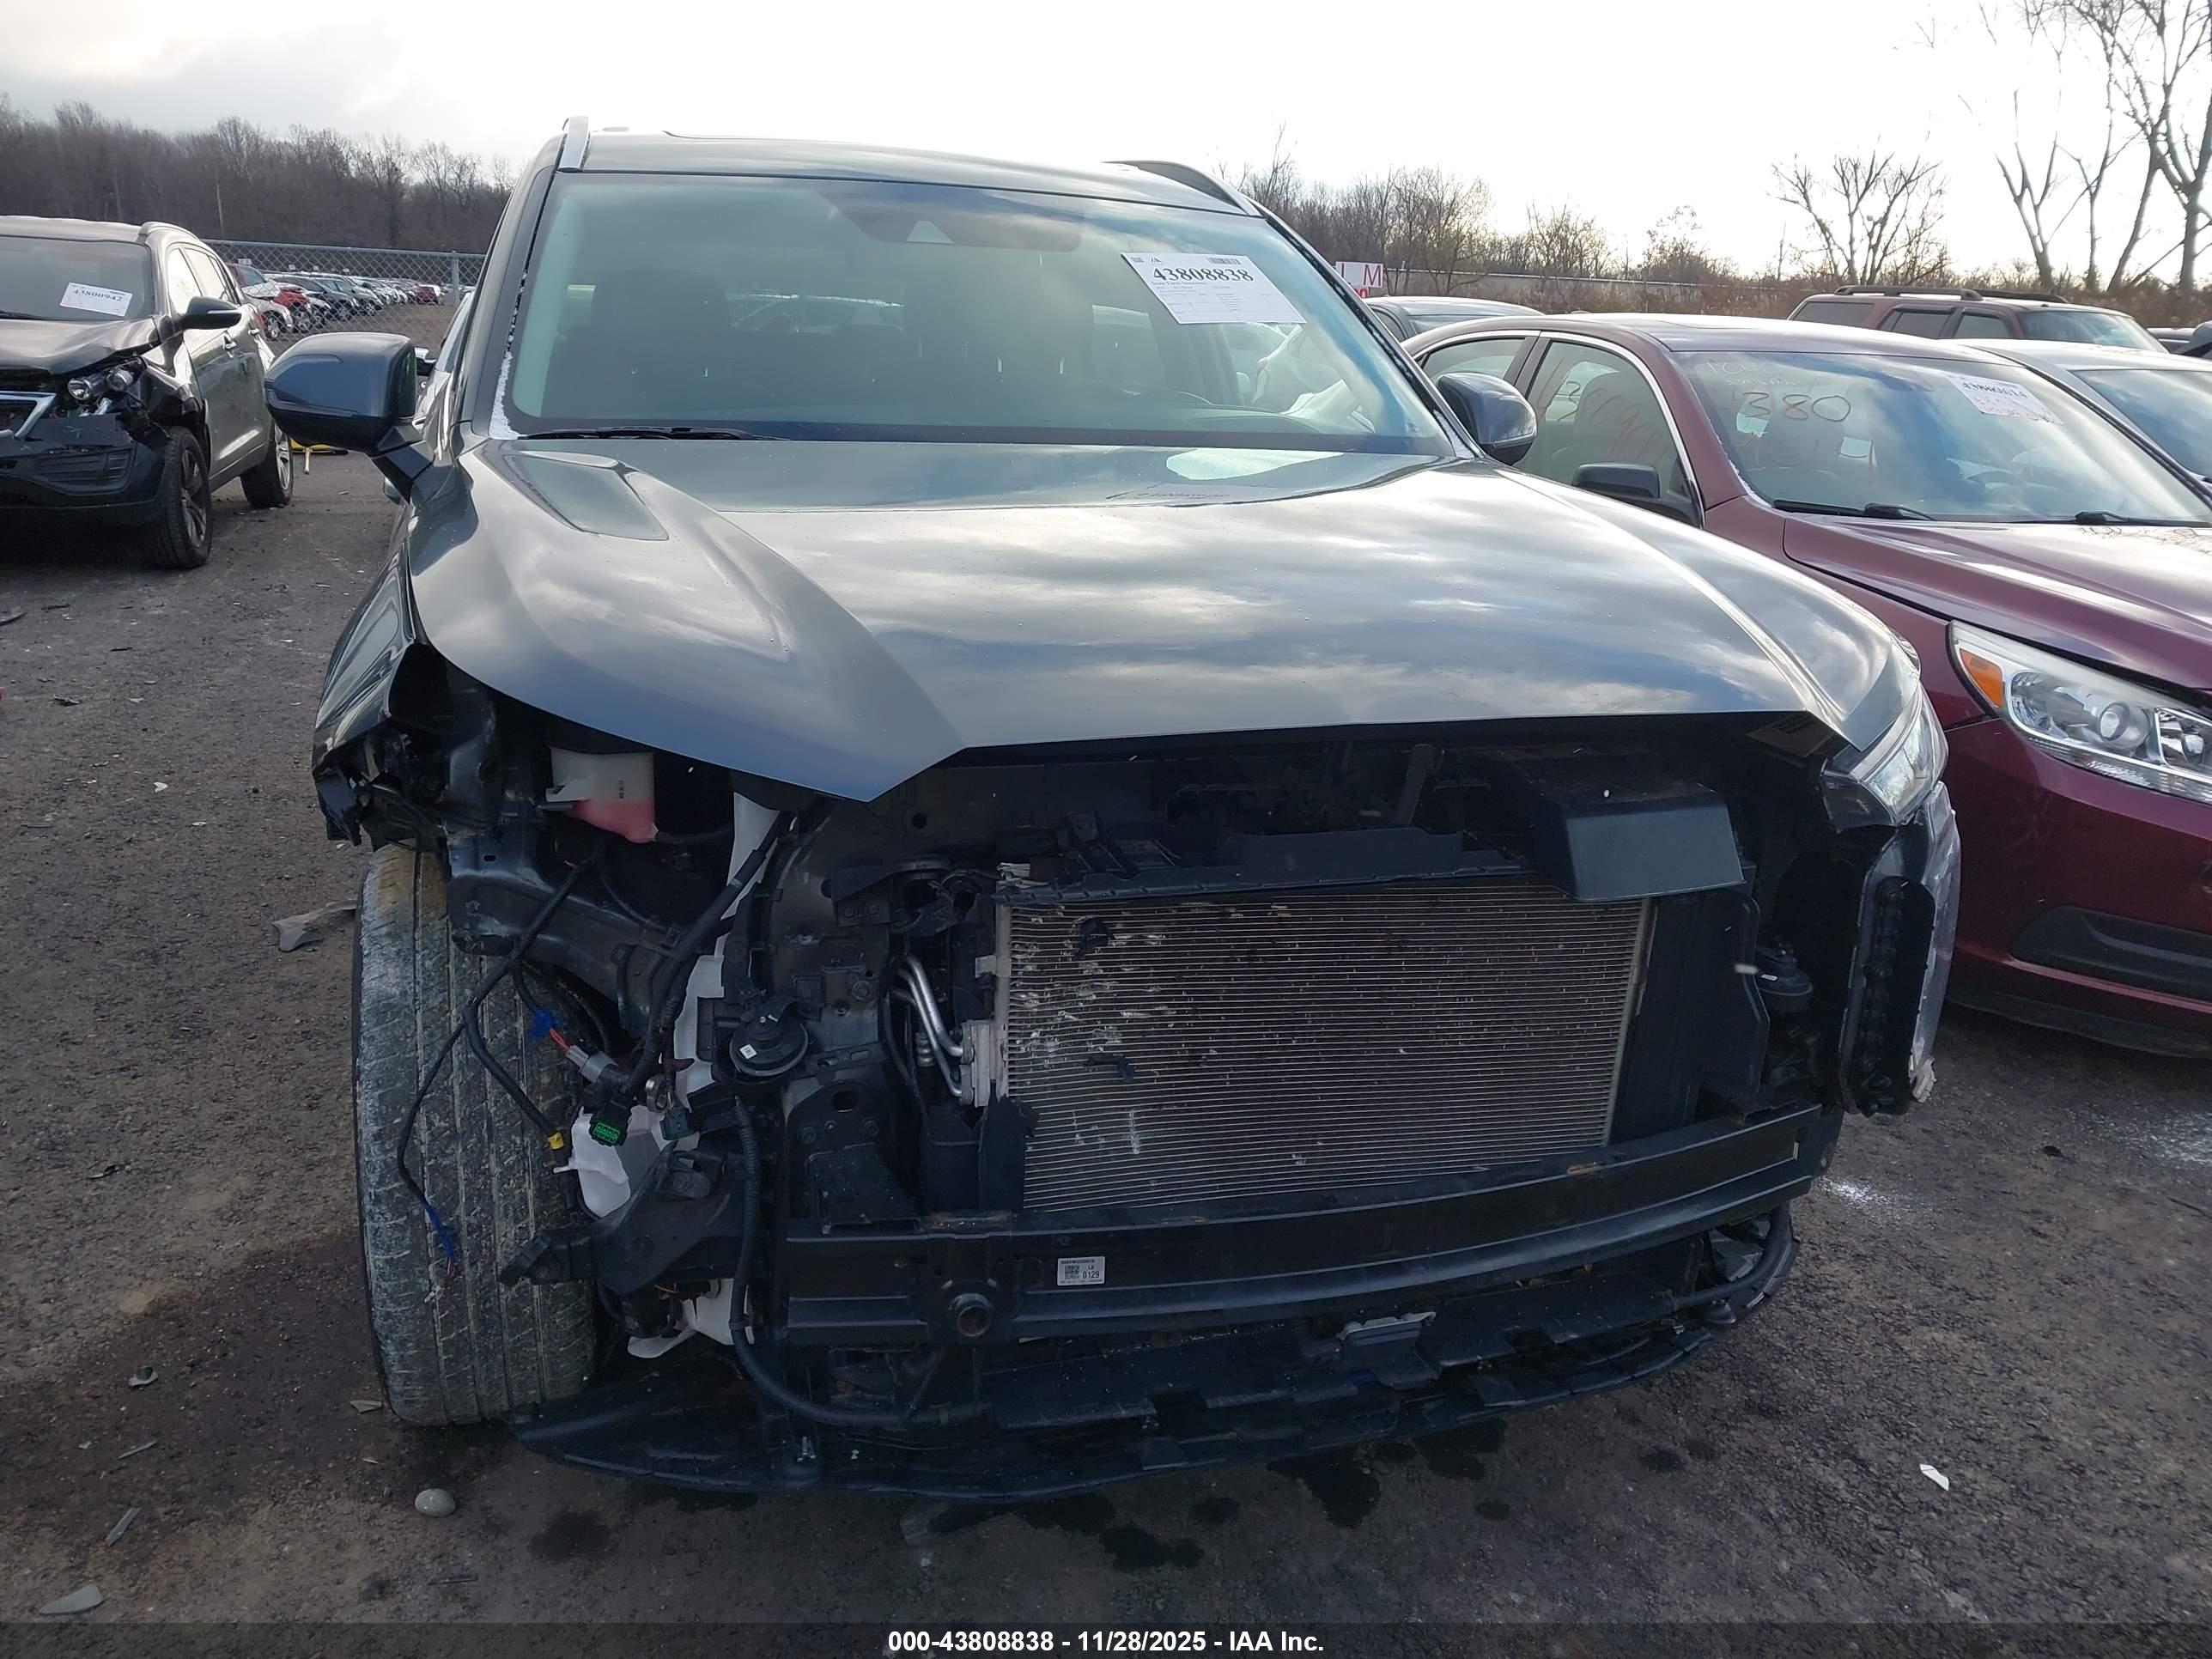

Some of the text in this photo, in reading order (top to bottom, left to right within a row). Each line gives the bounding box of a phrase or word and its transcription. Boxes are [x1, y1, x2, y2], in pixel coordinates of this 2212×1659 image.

[1153, 267, 1254, 282] 43808838
[1742, 391, 1852, 422] 380
[1083, 1270, 1100, 1279] 0129
